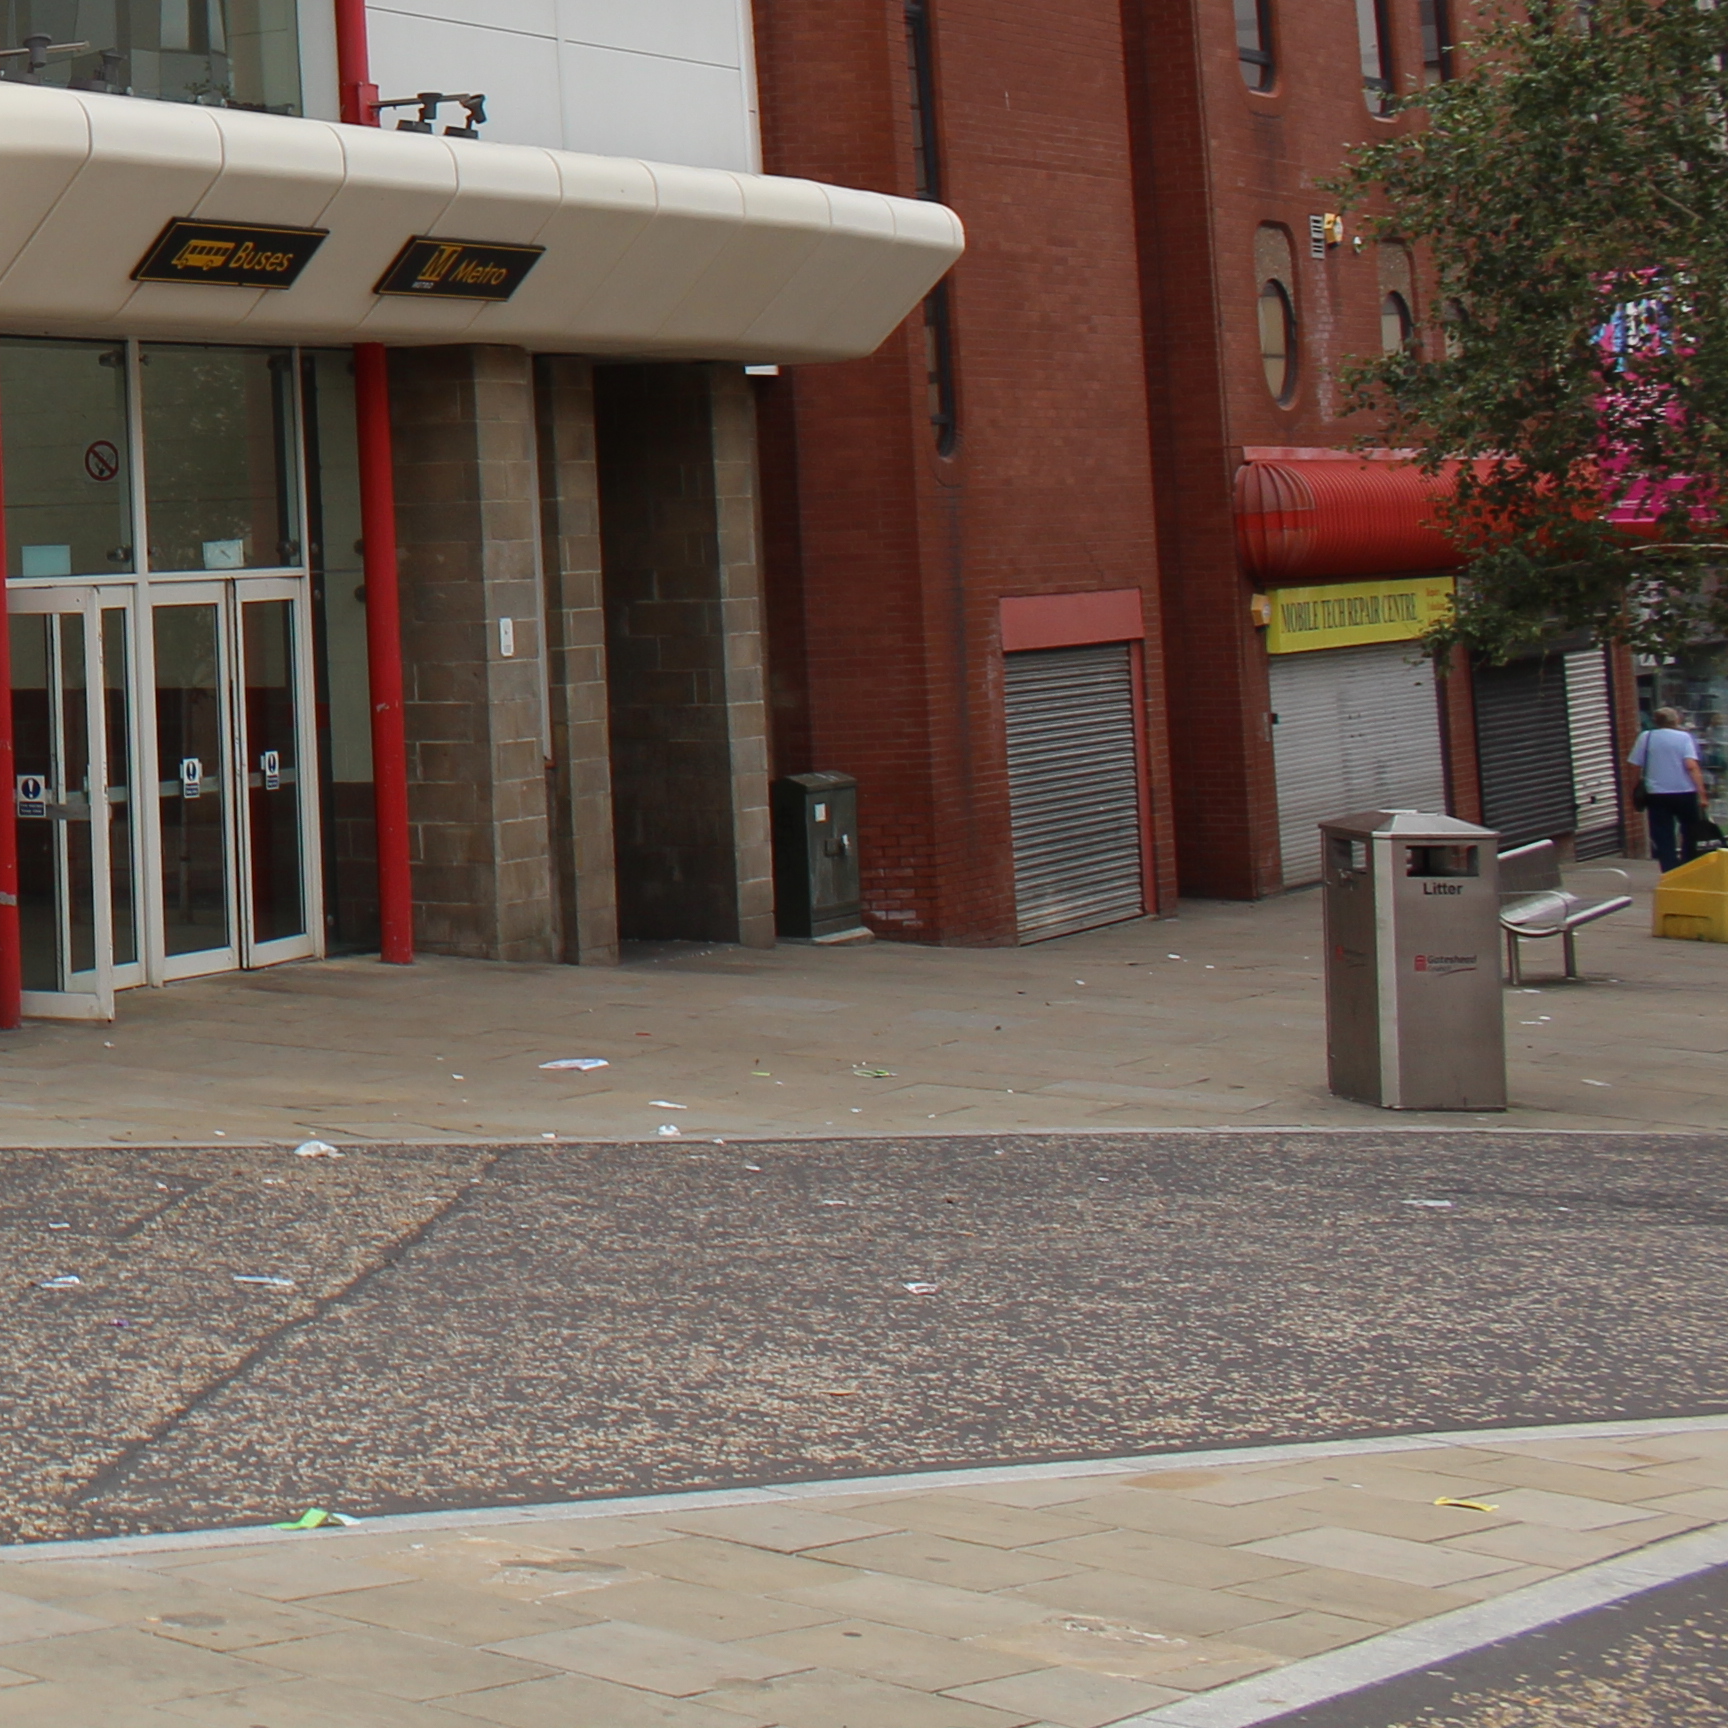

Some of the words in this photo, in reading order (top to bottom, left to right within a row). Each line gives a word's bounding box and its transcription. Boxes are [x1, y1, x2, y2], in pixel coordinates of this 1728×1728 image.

[228, 241, 293, 271] Buses
[448, 258, 509, 285] Metro
[1282, 601, 1319, 633] MOBILE
[1321, 598, 1345, 629] TECH
[1347, 595, 1381, 626] REPAIR
[1382, 593, 1417, 623] CENTRE
[1423, 882, 1463, 896] Litter
